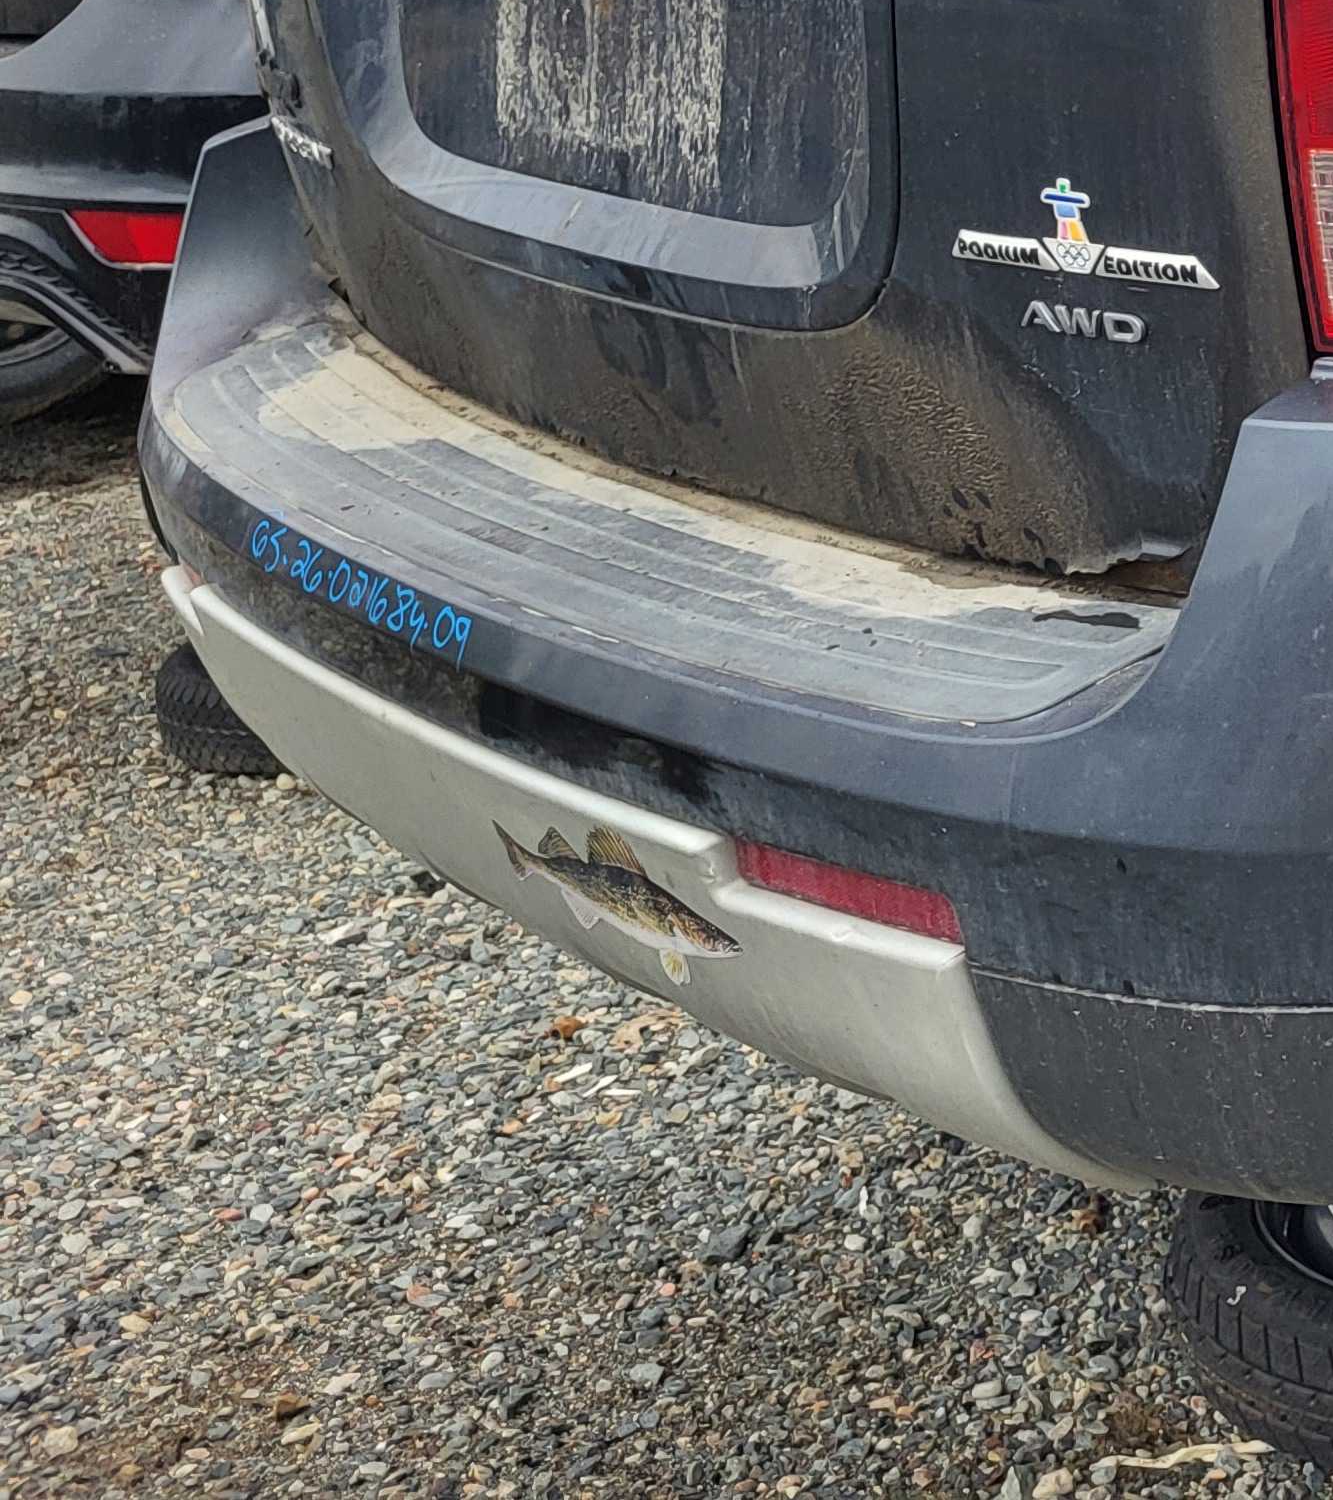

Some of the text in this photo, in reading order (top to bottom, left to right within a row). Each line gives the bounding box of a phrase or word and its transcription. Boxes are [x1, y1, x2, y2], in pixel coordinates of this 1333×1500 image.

[957, 237, 1199, 285] PODIUM EDITION
[1020, 299, 1148, 345] AWD
